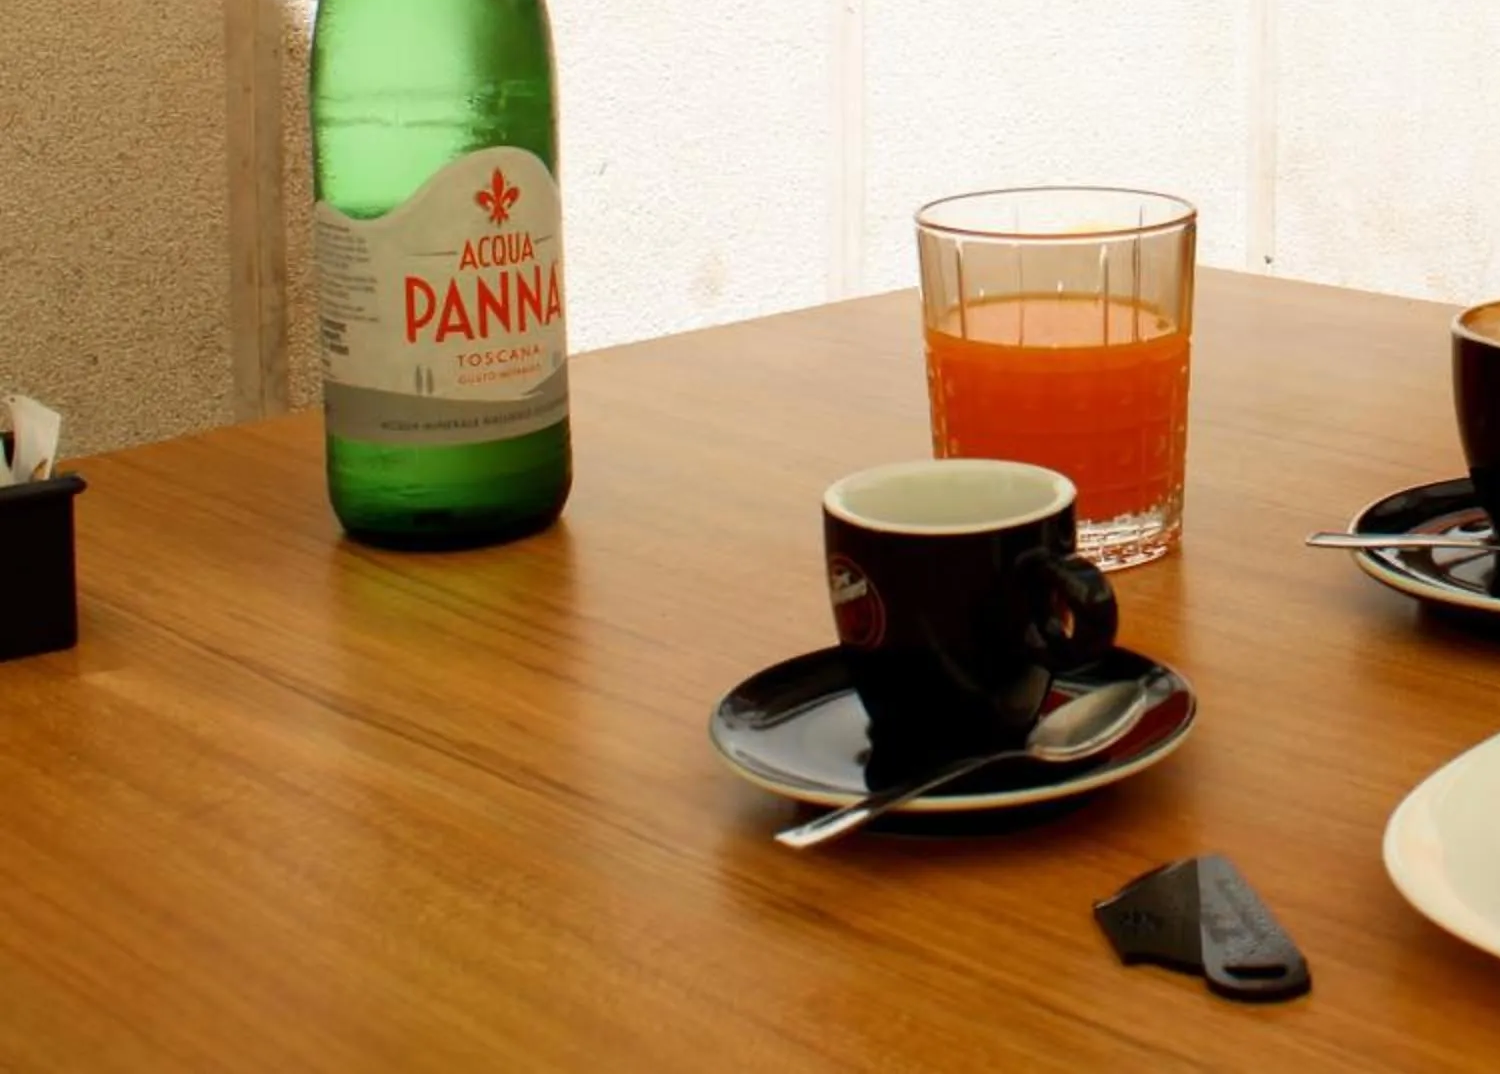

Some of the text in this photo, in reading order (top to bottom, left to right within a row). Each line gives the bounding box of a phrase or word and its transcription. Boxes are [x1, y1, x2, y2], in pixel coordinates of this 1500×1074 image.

[459, 232, 535, 271] ACQUA
[404, 260, 562, 344] PANNA
[456, 344, 541, 367] TOSCANA
